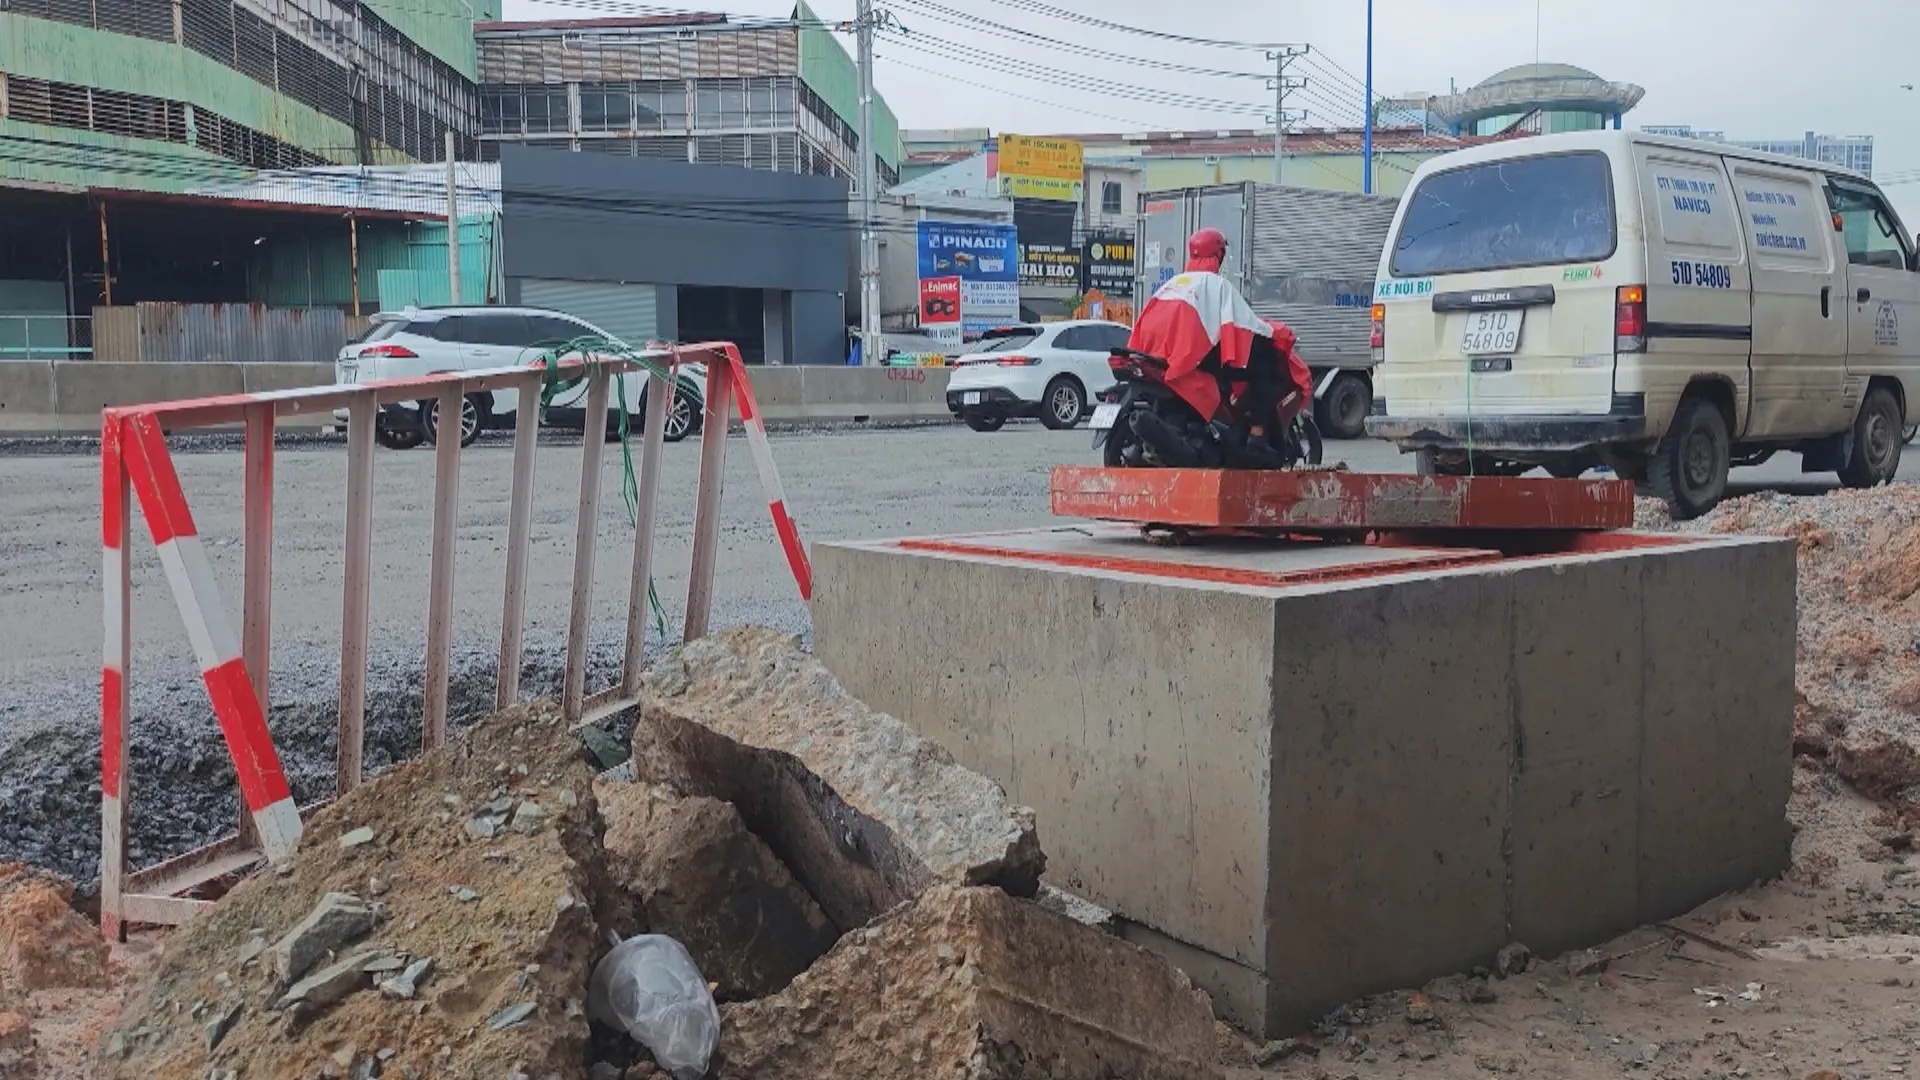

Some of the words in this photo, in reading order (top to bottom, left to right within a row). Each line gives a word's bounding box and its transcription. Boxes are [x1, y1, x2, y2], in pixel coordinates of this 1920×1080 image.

[1673, 195, 1712, 214] NAVICO
[943, 235, 1007, 249] PINACO
[1562, 267, 1592, 281] EURO
[1592, 265, 1604, 280] 4
[1671, 261, 1692, 285] 51D
[1694, 262, 1731, 288] 54809
[1378, 283, 1391, 296] XE
[1471, 292, 1511, 303] SUZUKI
[1477, 313, 1508, 331] 51D
[1462, 331, 1515, 351] 548.09
